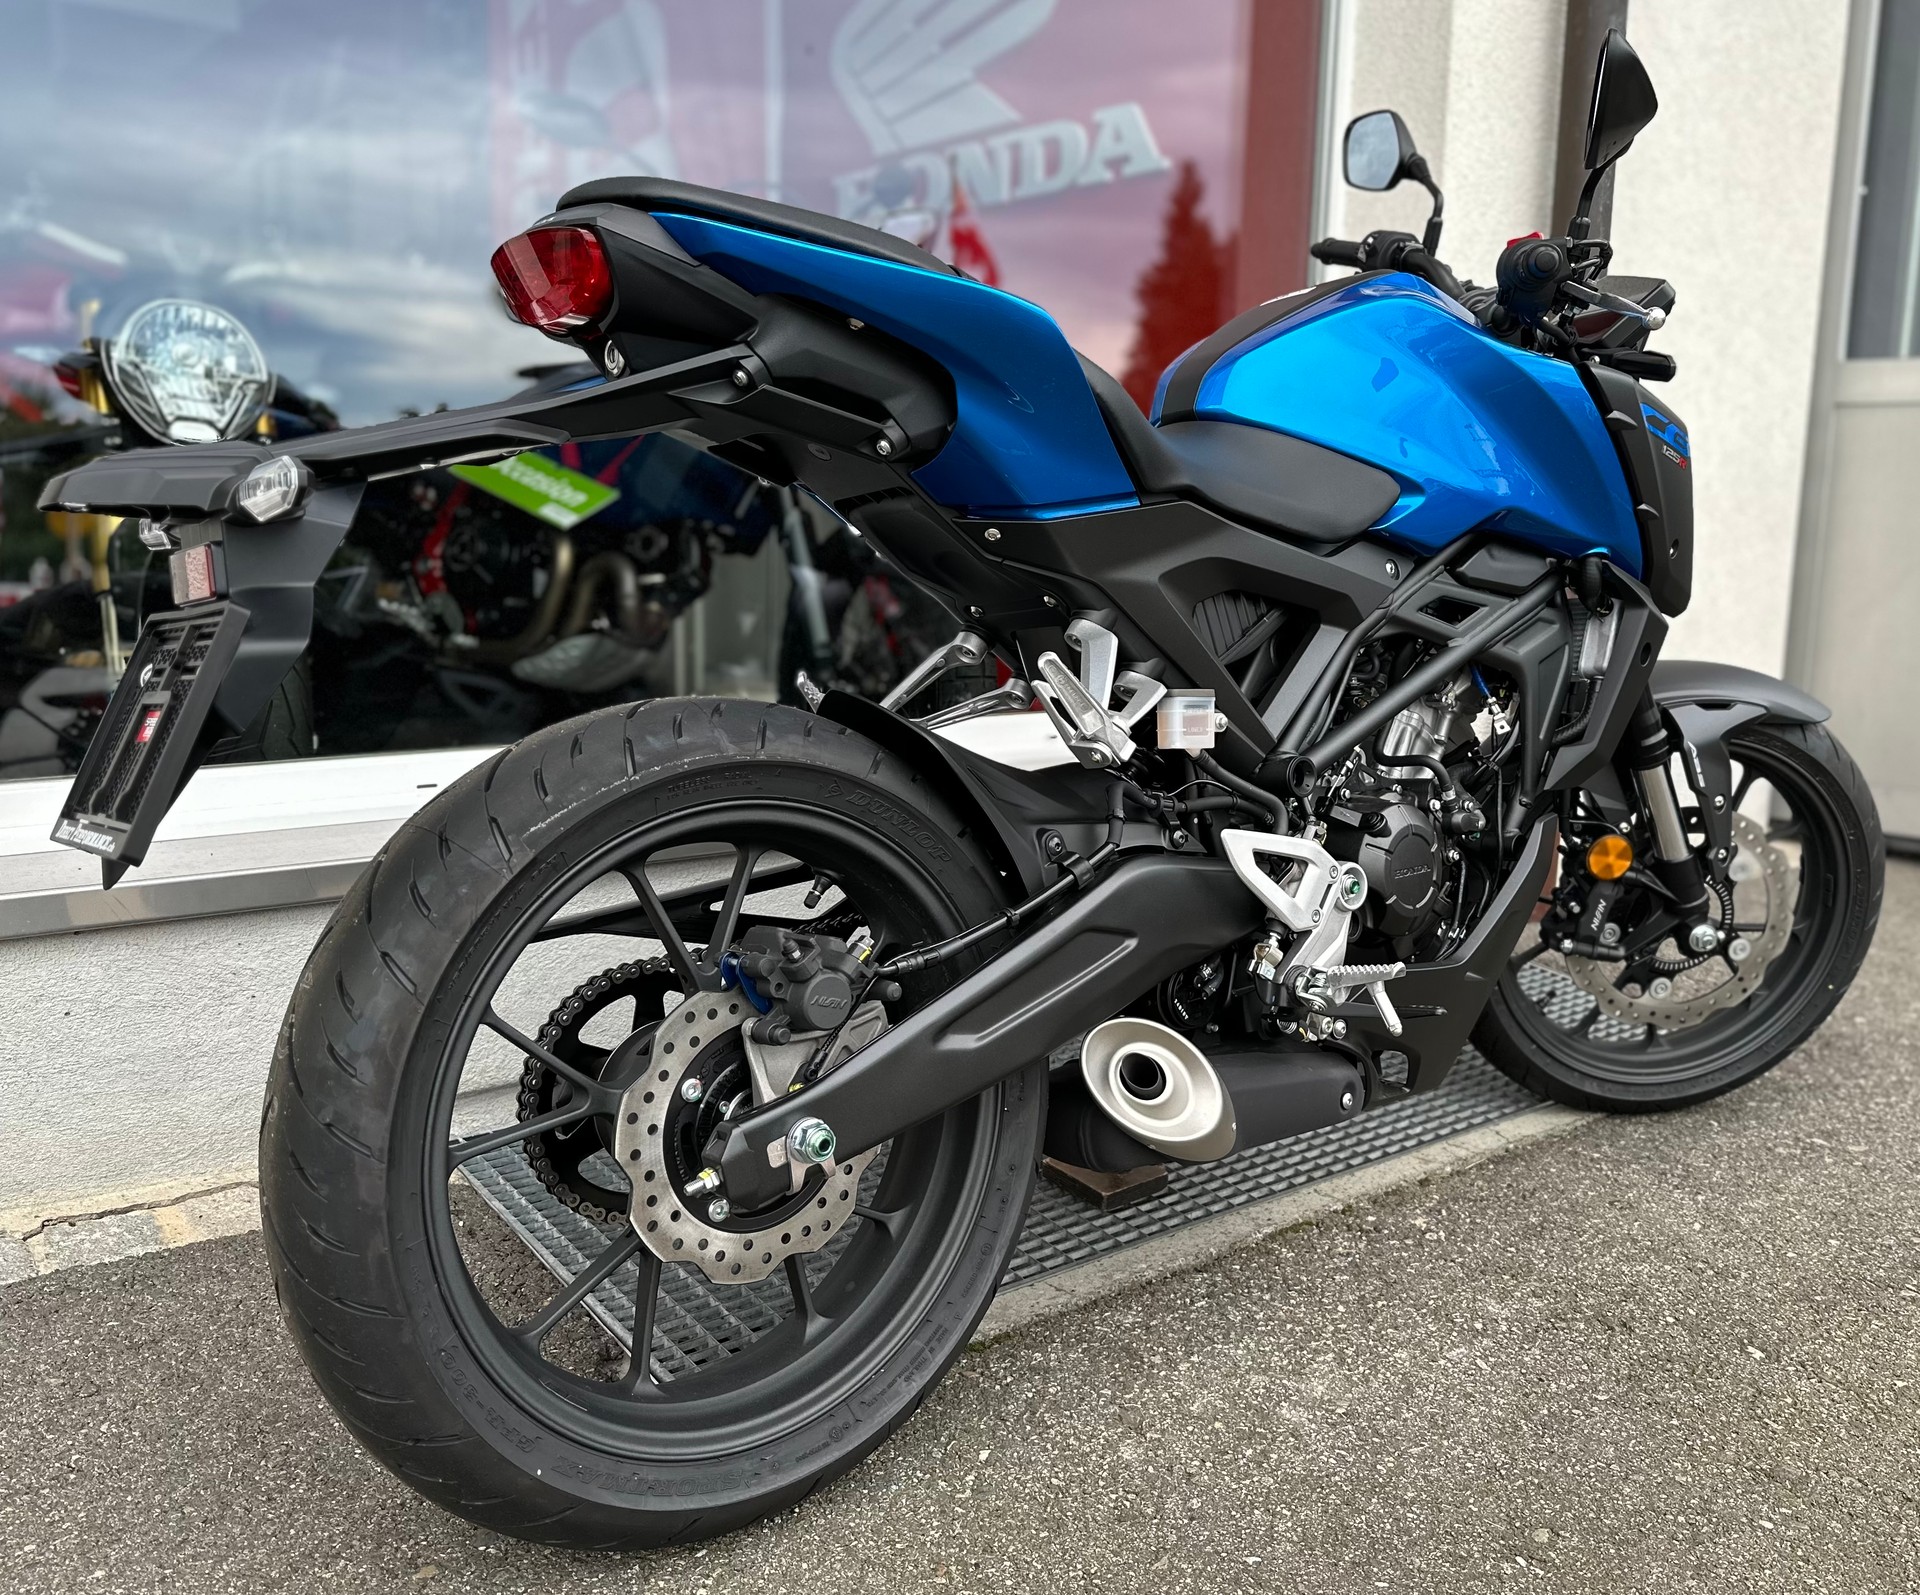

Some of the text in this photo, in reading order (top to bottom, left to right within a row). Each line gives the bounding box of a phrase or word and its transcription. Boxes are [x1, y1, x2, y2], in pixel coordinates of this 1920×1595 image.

[1661, 443, 1688, 470] 125R
[846, 790, 953, 862] DUNLOP
[551, 1455, 744, 1497] SPORTMAX
